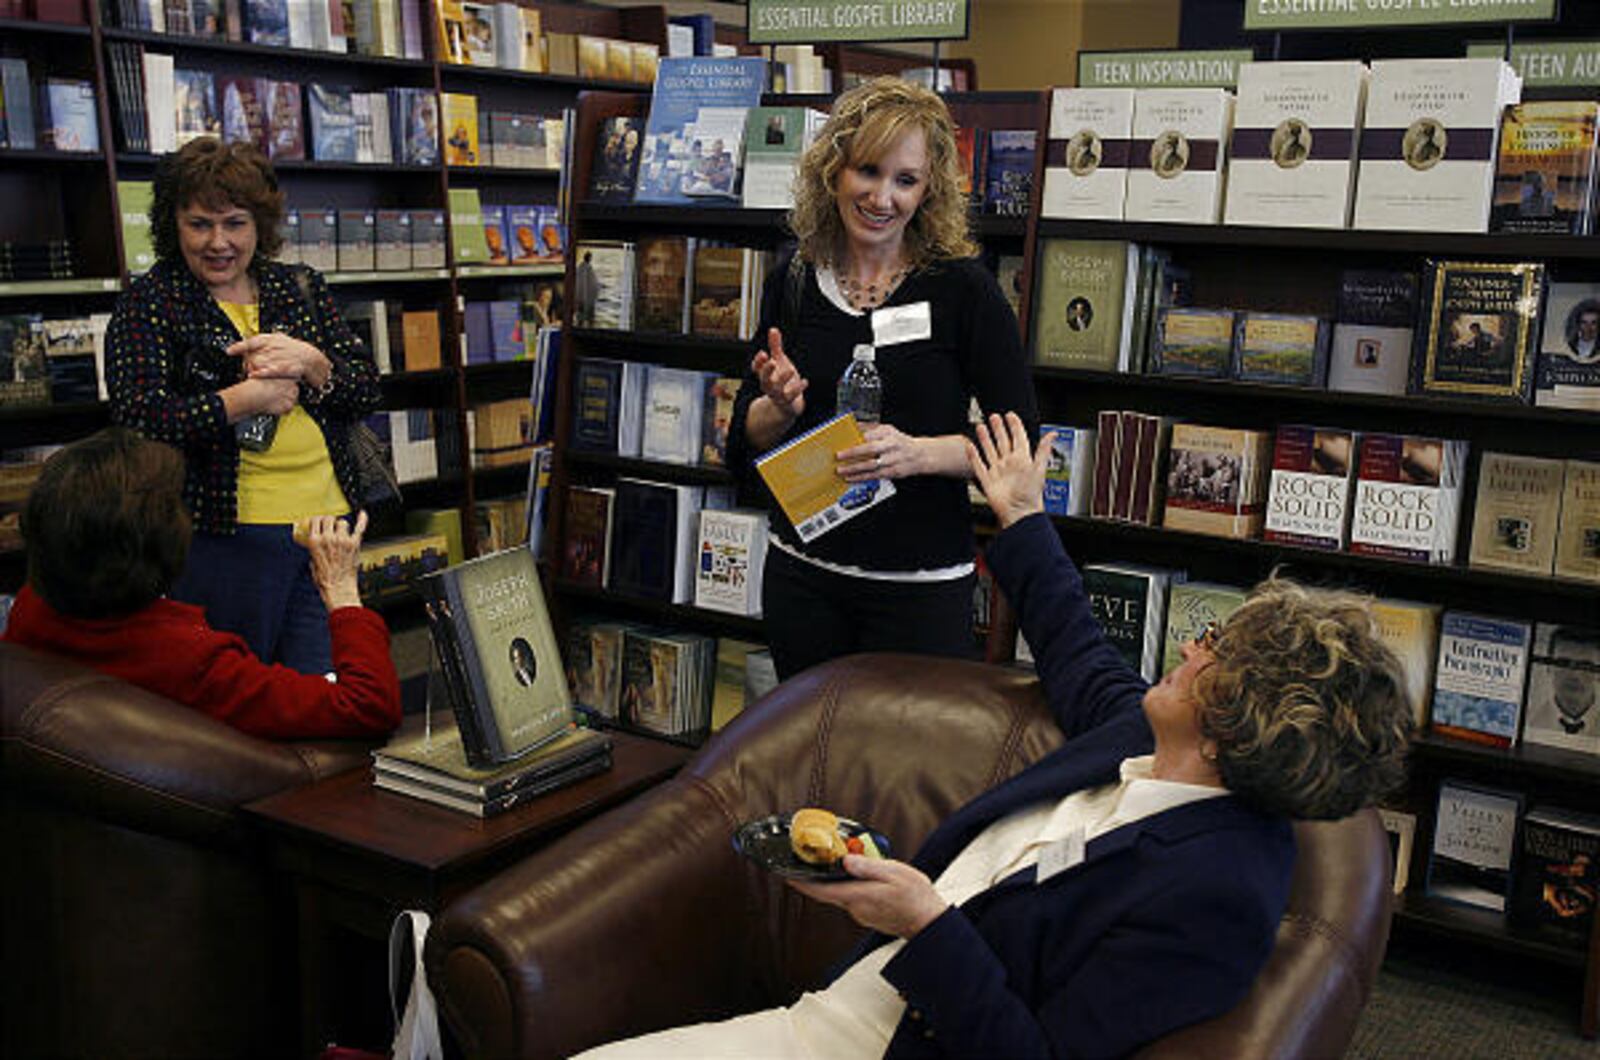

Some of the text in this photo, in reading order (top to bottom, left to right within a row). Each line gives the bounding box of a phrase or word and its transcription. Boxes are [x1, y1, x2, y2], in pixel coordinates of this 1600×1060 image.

[757, 2, 956, 30] ESSENTIAL GOSPEL LIBRARY
[1094, 59, 1234, 84] TEEN INSPIRATION
[1518, 51, 1600, 79] TEEN AU
[1276, 477, 1341, 500] ROCK
[1361, 485, 1433, 511] ROCK
[1272, 496, 1342, 520] SOLID
[1359, 506, 1433, 532] SOLID
[475, 572, 530, 605] JOSEPH
